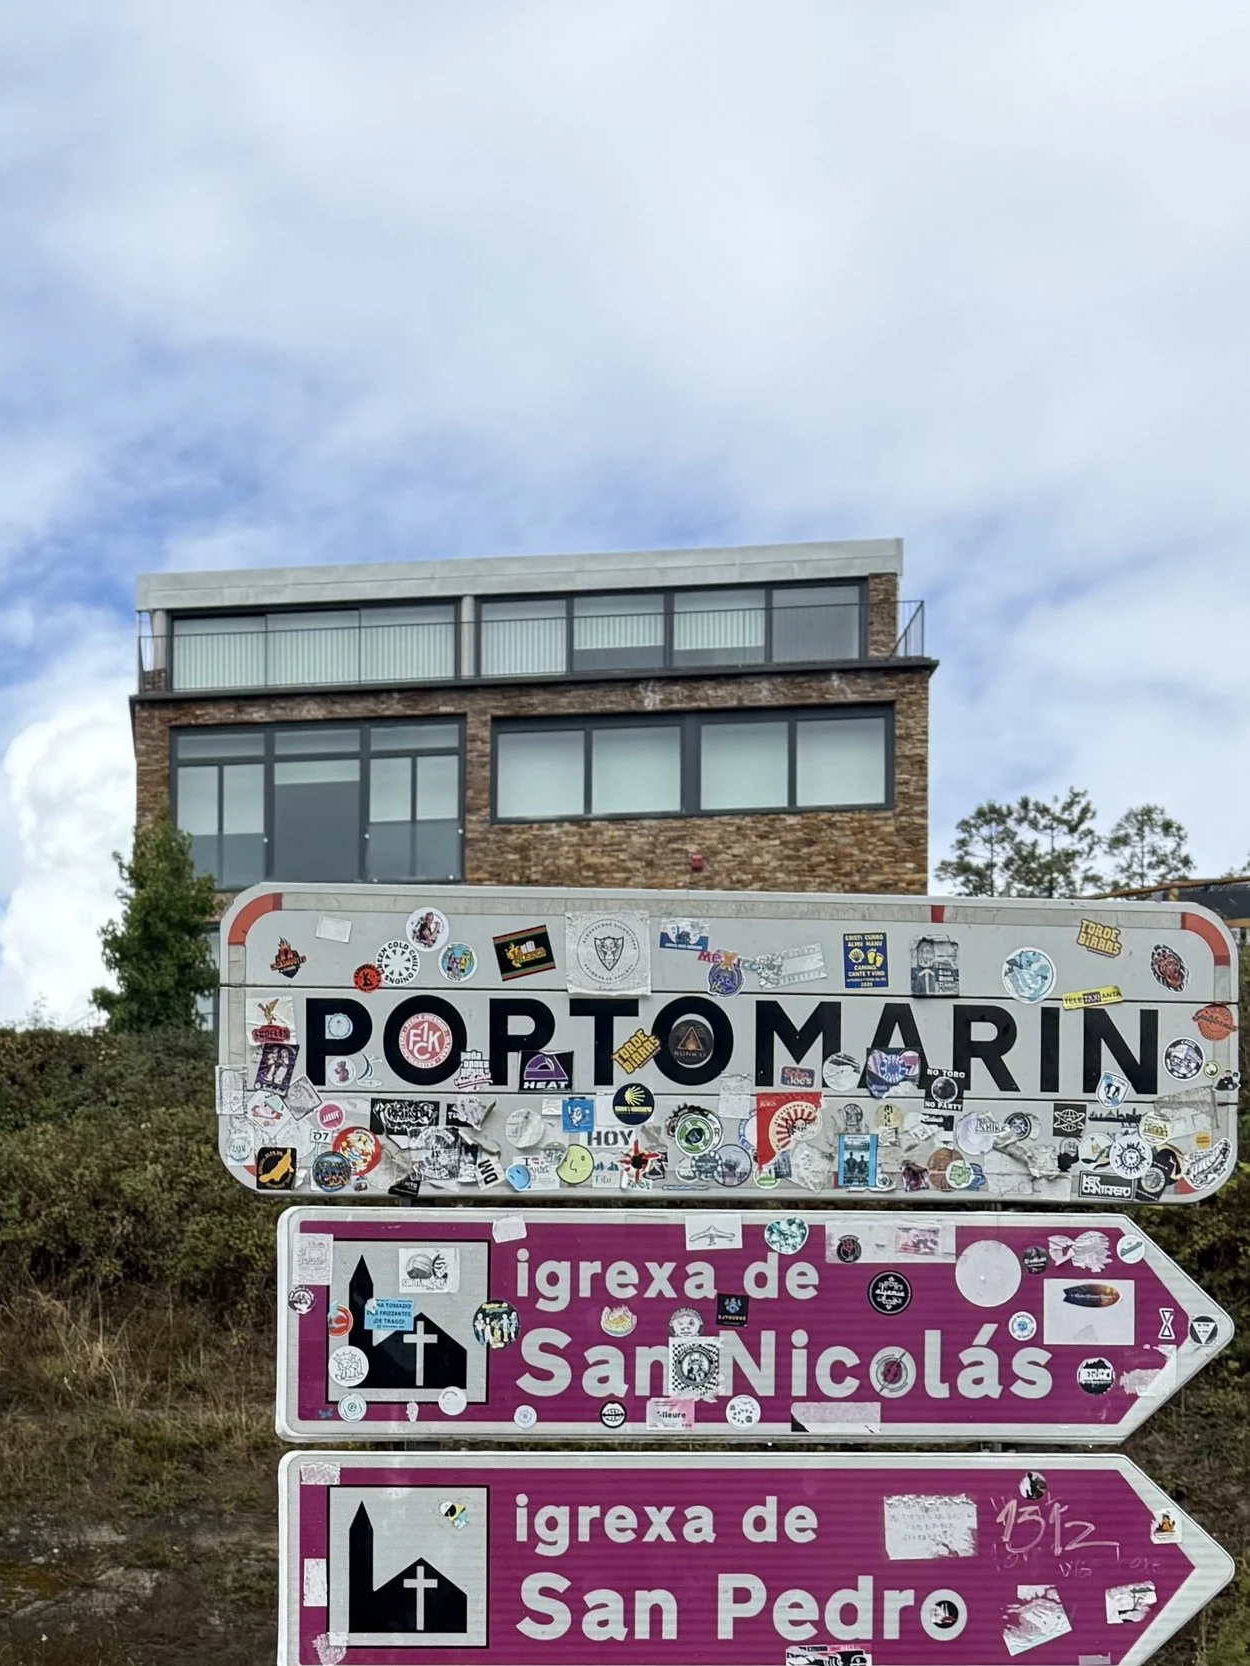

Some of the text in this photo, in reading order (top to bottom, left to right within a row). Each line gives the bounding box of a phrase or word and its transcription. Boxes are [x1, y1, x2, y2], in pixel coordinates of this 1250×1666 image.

[387, 941, 410, 951] COLD
[408, 950, 419, 973] CHILI
[384, 972, 415, 985] ONIONS
[305, 995, 1158, 1095] PORTOMARIN
[926, 1068, 966, 1078] NO TORO
[523, 1080, 569, 1090] HEAT
[924, 1101, 963, 1111] NO PARTY
[587, 1130, 634, 1147] HOY
[516, 1248, 819, 1312] igrexa de
[516, 1324, 1053, 1399] San Nicolás
[516, 1493, 817, 1557] igrexa de
[516, 1572, 968, 1641] San Pedro
